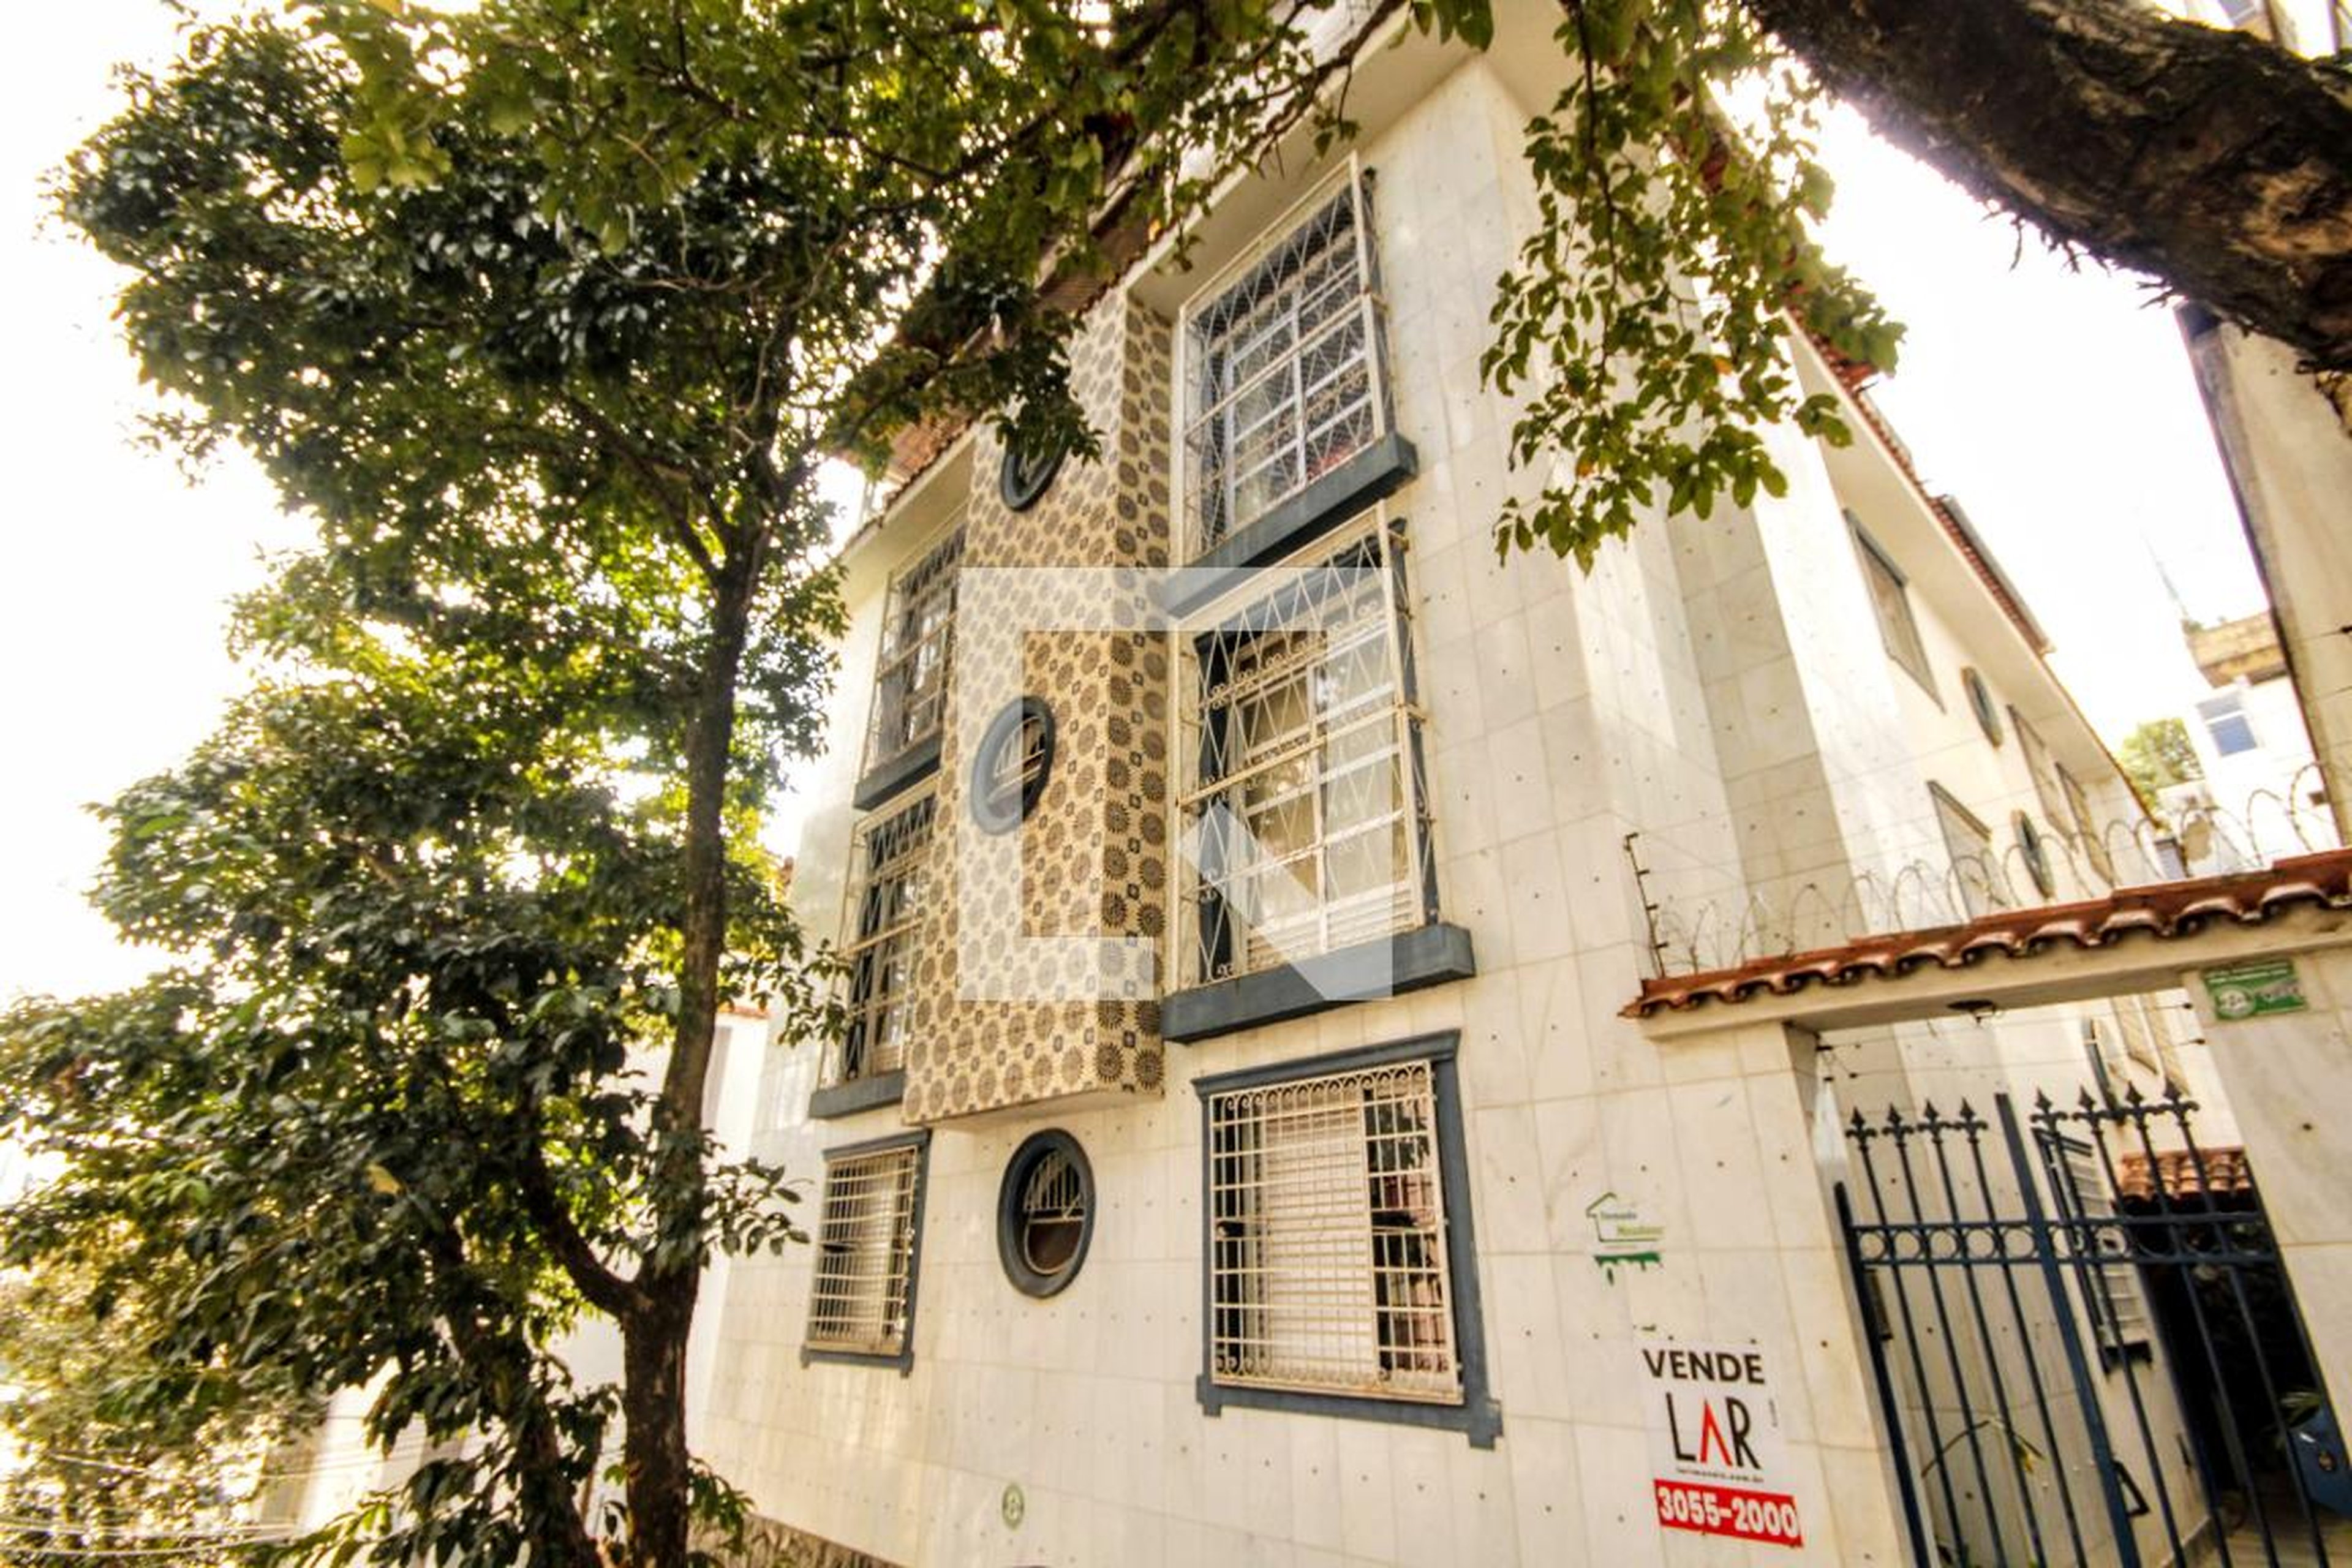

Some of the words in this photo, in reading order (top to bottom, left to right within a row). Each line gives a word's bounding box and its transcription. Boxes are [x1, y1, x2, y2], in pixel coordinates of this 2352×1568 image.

[1643, 1349, 1765, 1384] VENDE
[1665, 1392, 1761, 1469] LAR
[1658, 1487, 1799, 1538] 3055-2000
